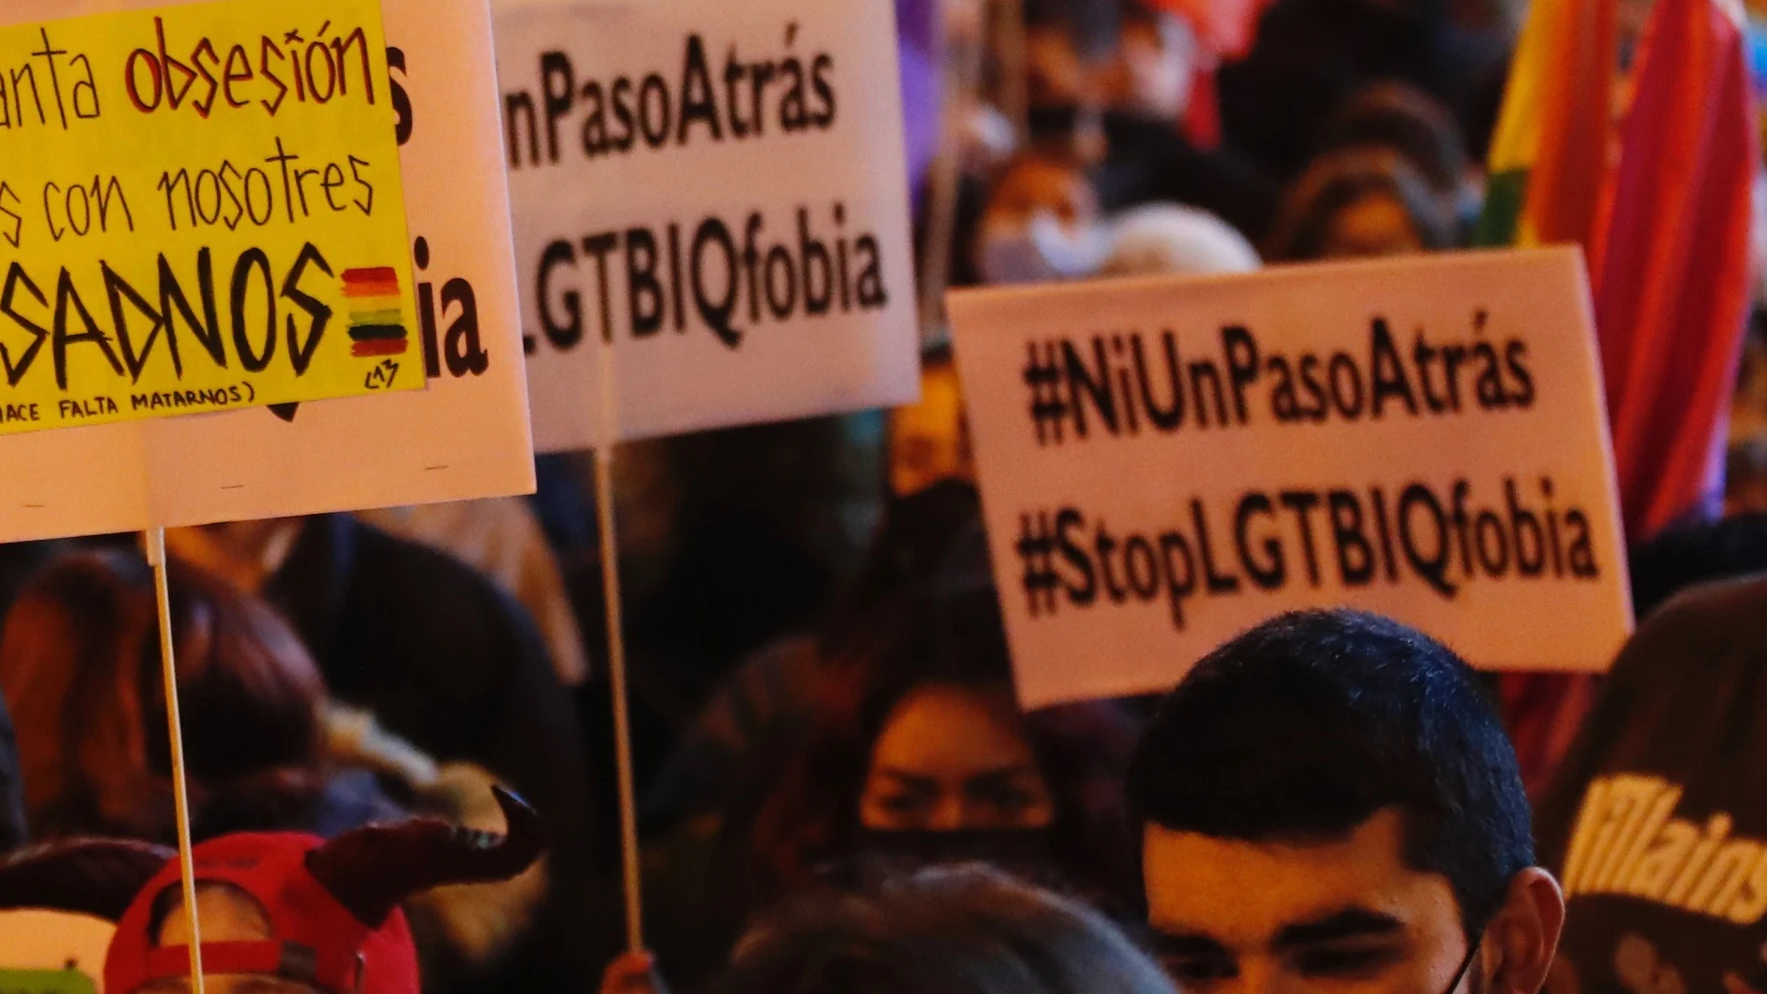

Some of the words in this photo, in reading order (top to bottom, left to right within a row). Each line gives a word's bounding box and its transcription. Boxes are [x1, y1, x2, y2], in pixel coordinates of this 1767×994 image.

[124, 15, 376, 120] obsesión
[503, 20, 838, 171] nPasoAtrás
[43, 173, 135, 243] con
[157, 135, 374, 232] nosotres
[523, 202, 889, 356] GTBIQfobia
[58, 395, 120, 420] FALTA
[130, 380, 256, 412] MATARNOS)
[1021, 309, 1538, 448] #NiUnPasoAtrás
[1015, 476, 1601, 631] #StopLGTBIQfobia
